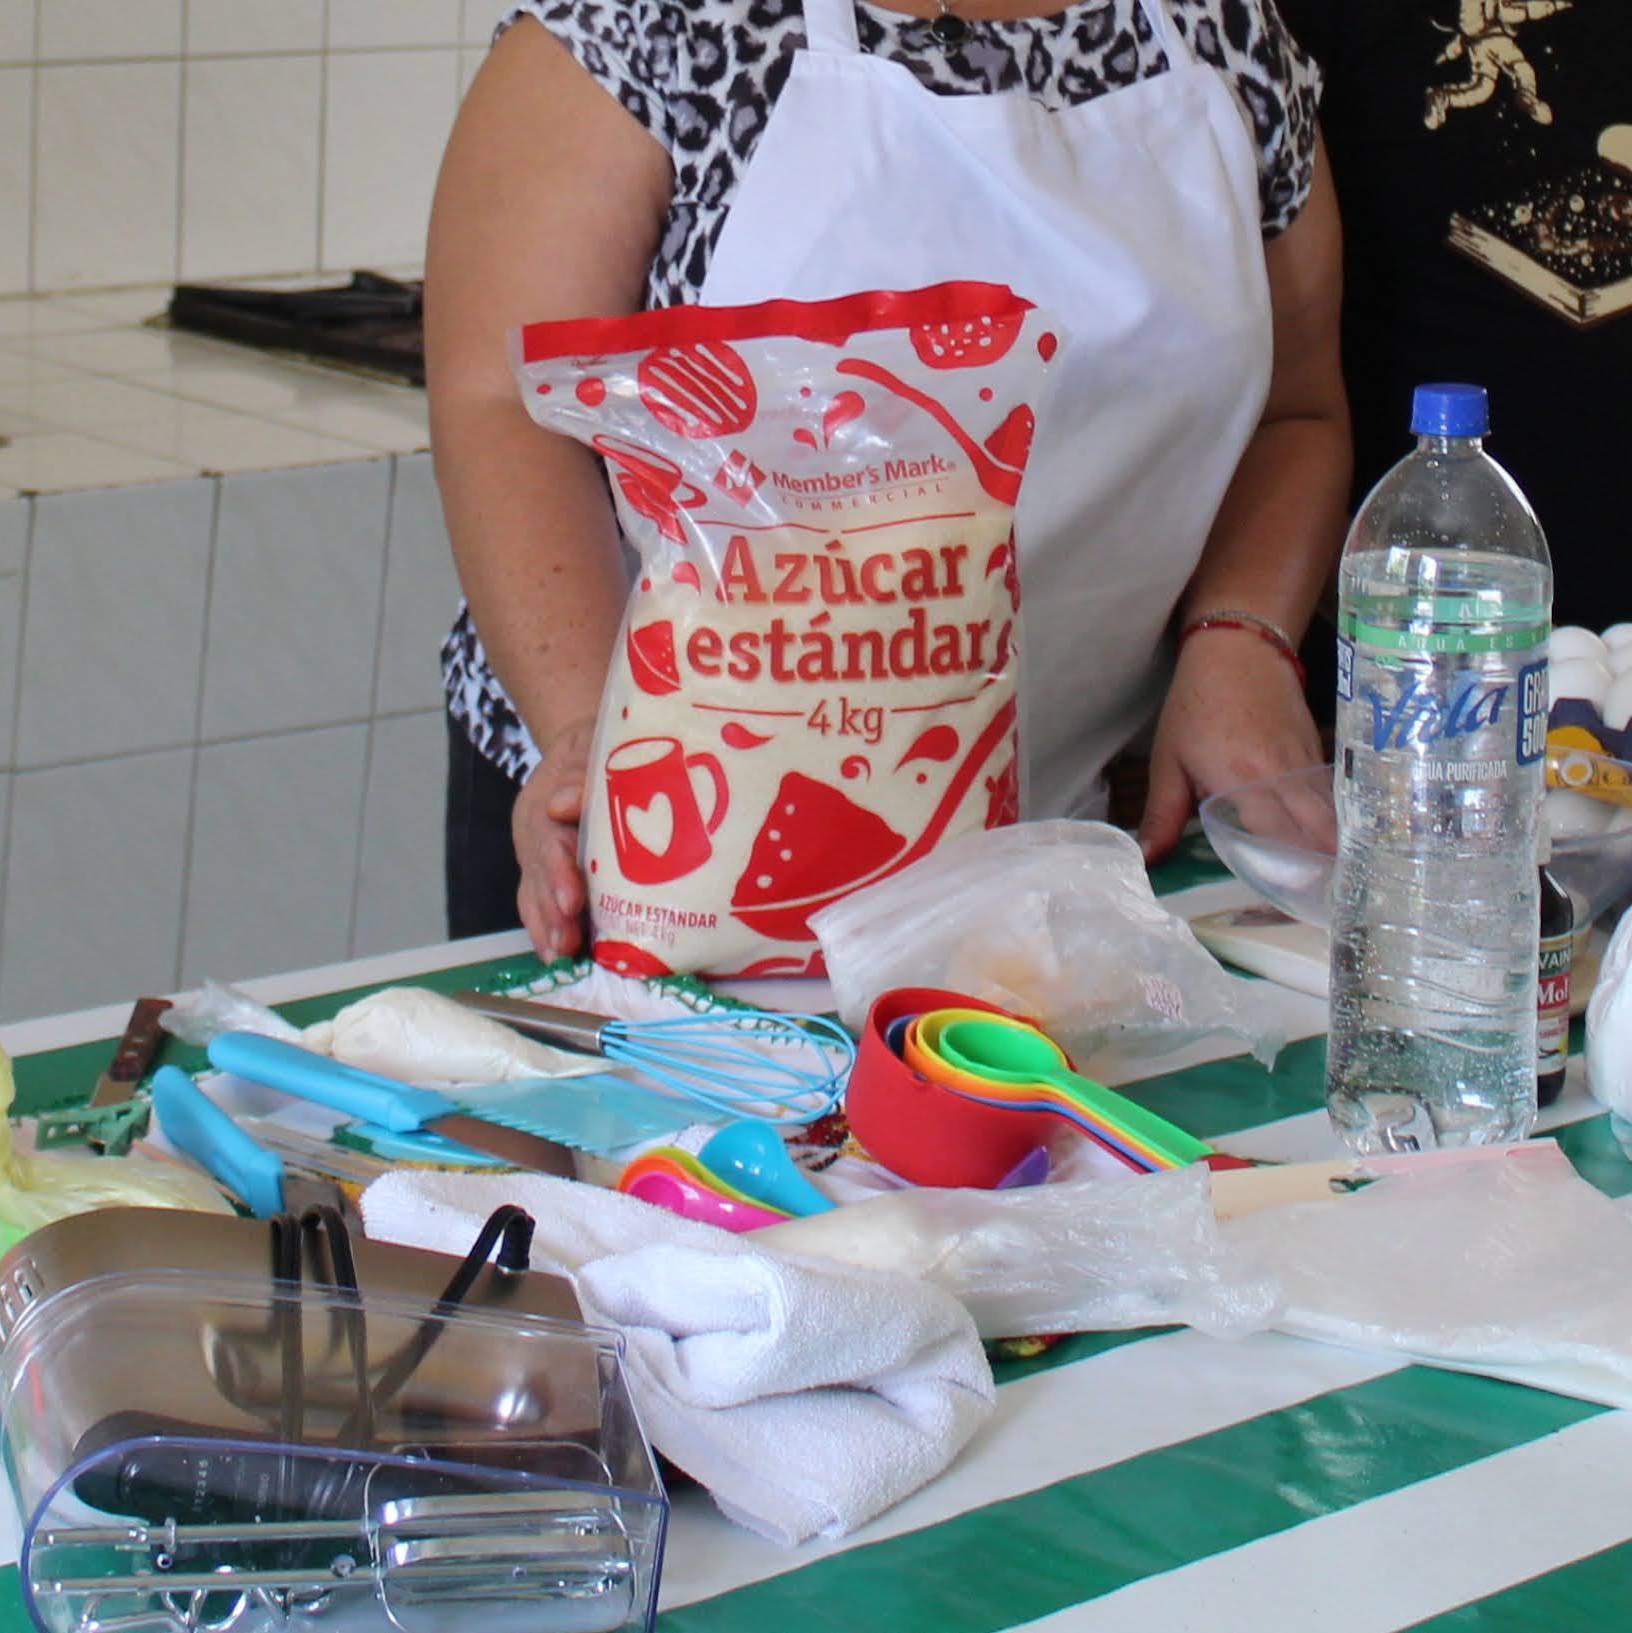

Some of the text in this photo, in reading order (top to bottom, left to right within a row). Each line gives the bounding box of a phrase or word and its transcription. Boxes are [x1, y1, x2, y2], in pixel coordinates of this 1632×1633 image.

[771, 464, 880, 494] Member's
[781, 483, 944, 512] COMMERCIAL
[714, 533, 970, 606] Azúcar
[686, 607, 992, 683] estándar
[806, 695, 885, 745] 4 kg
[1446, 759, 1508, 782] PURIFICADA
